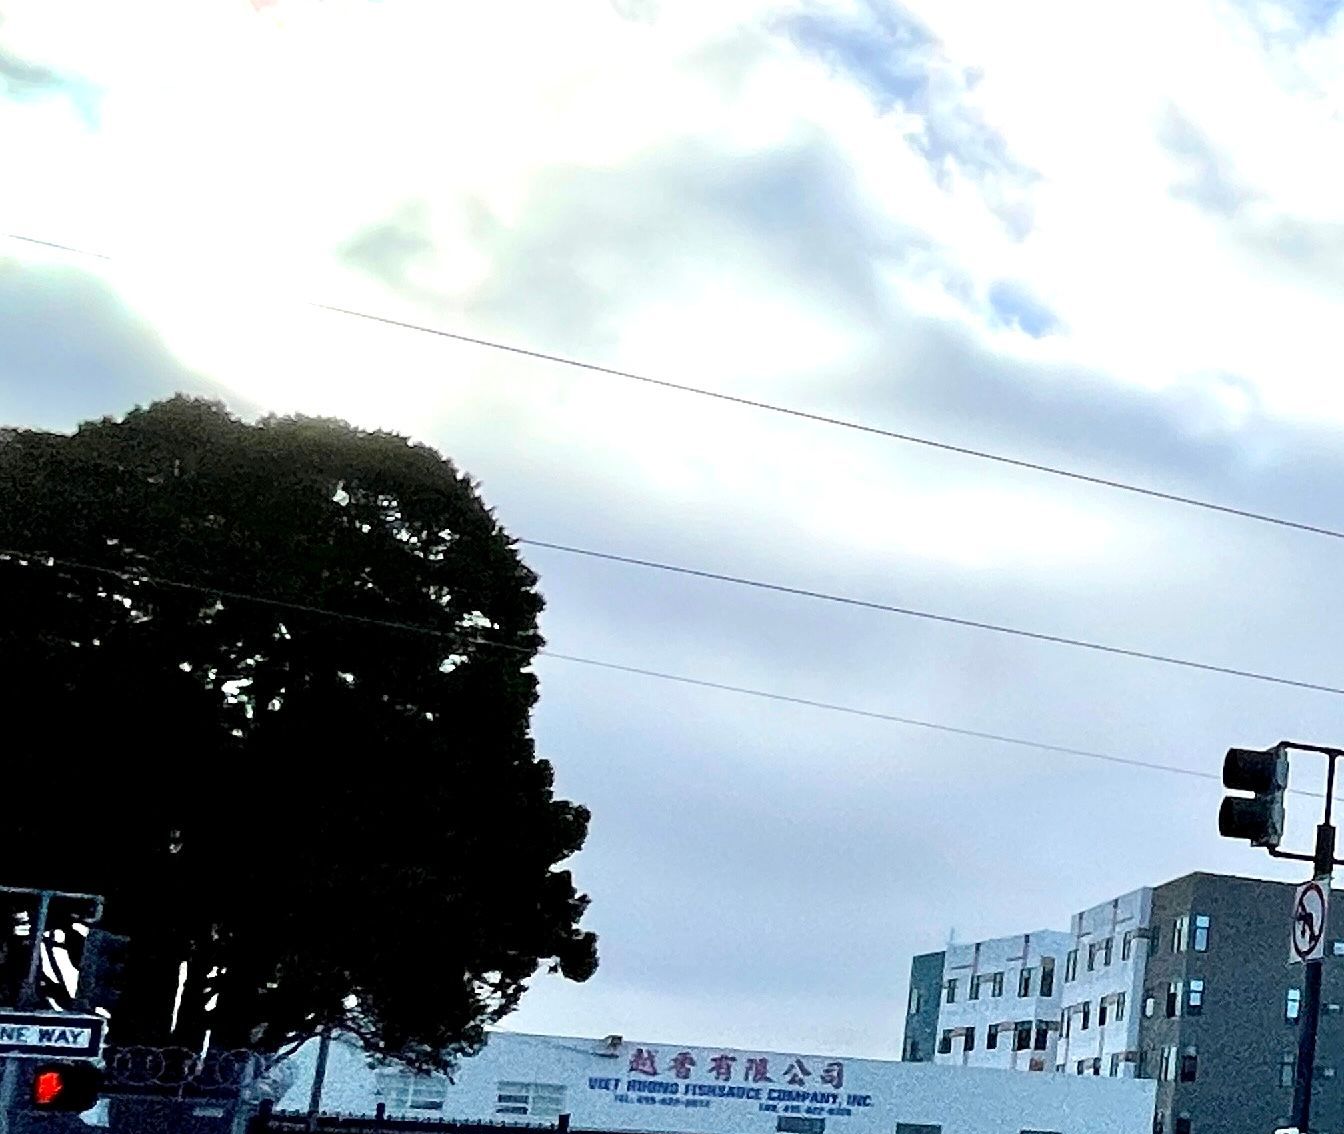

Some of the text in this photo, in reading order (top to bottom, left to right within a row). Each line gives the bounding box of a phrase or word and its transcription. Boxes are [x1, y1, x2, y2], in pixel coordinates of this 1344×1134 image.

[0, 1026, 85, 1044] NE WAY
[628, 1048, 844, 1089] 越香有限公司
[588, 1077, 620, 1091] VIET
[684, 1083, 761, 1100] FISHSAUCE
